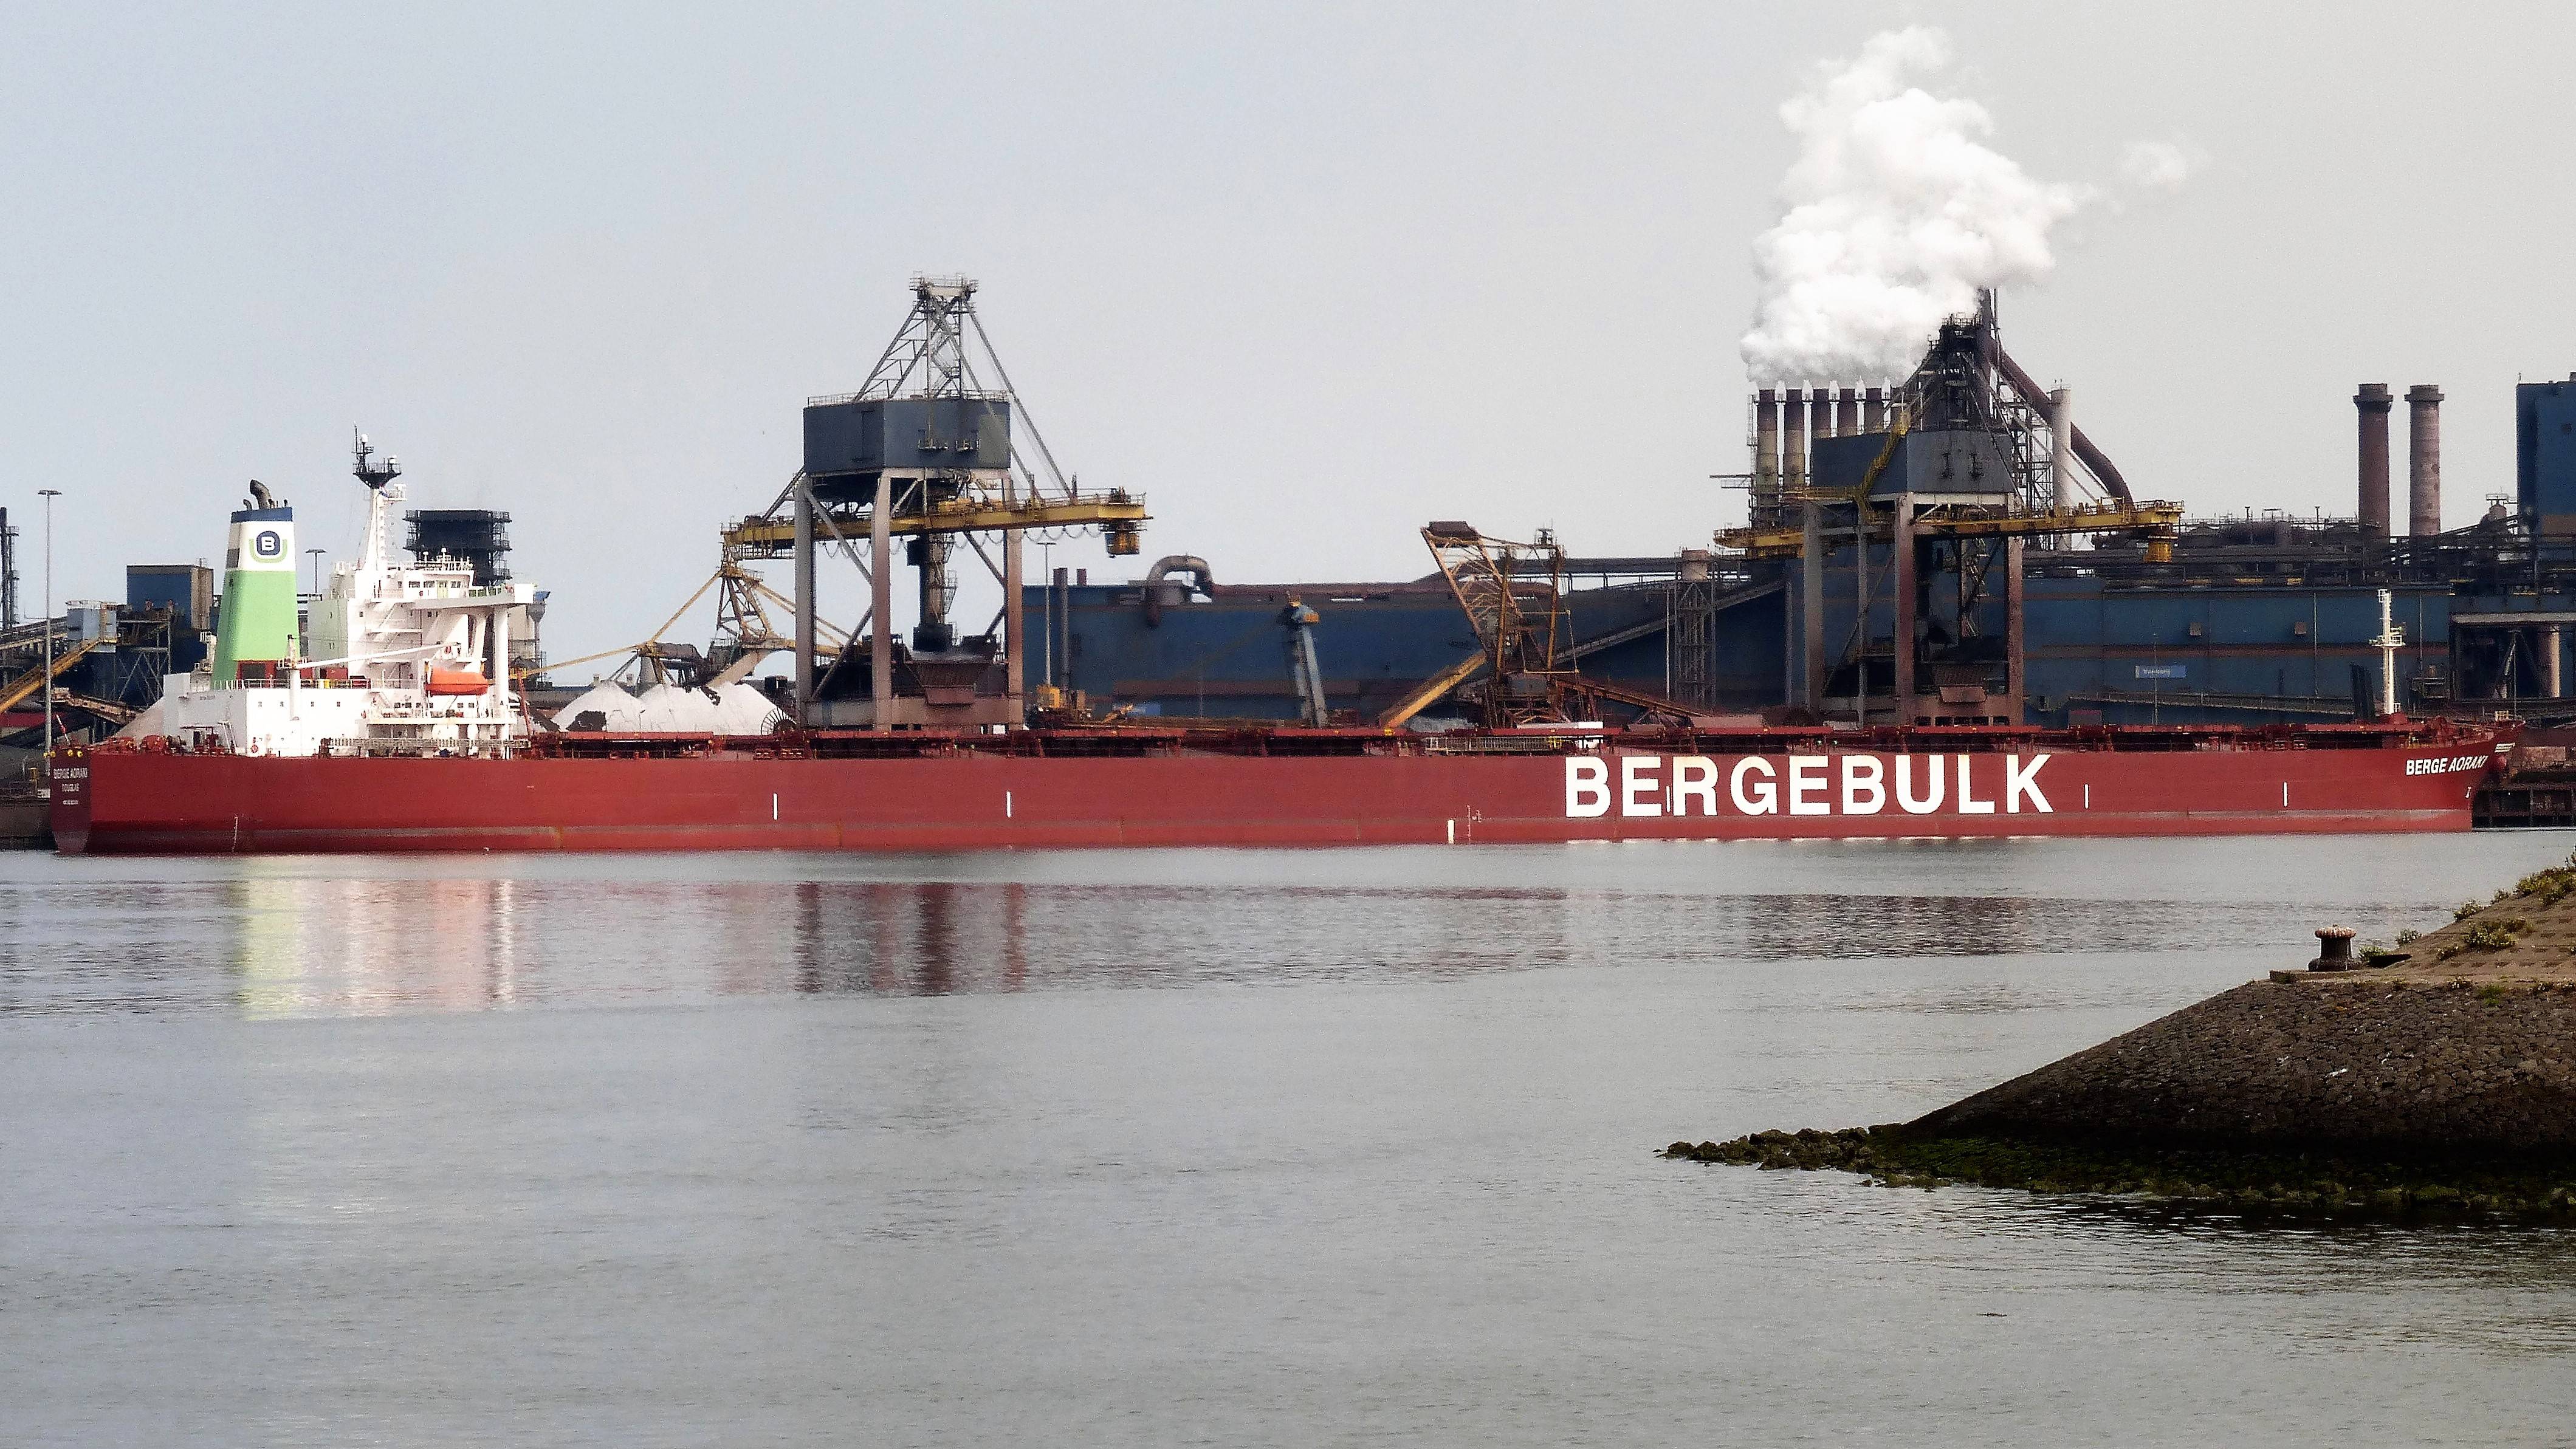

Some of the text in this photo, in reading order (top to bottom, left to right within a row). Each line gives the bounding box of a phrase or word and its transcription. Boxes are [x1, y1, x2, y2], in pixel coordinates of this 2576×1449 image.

[1565, 754, 2054, 817] BERGEBULK
[2406, 755, 2489, 775] BERGE AORAKI
